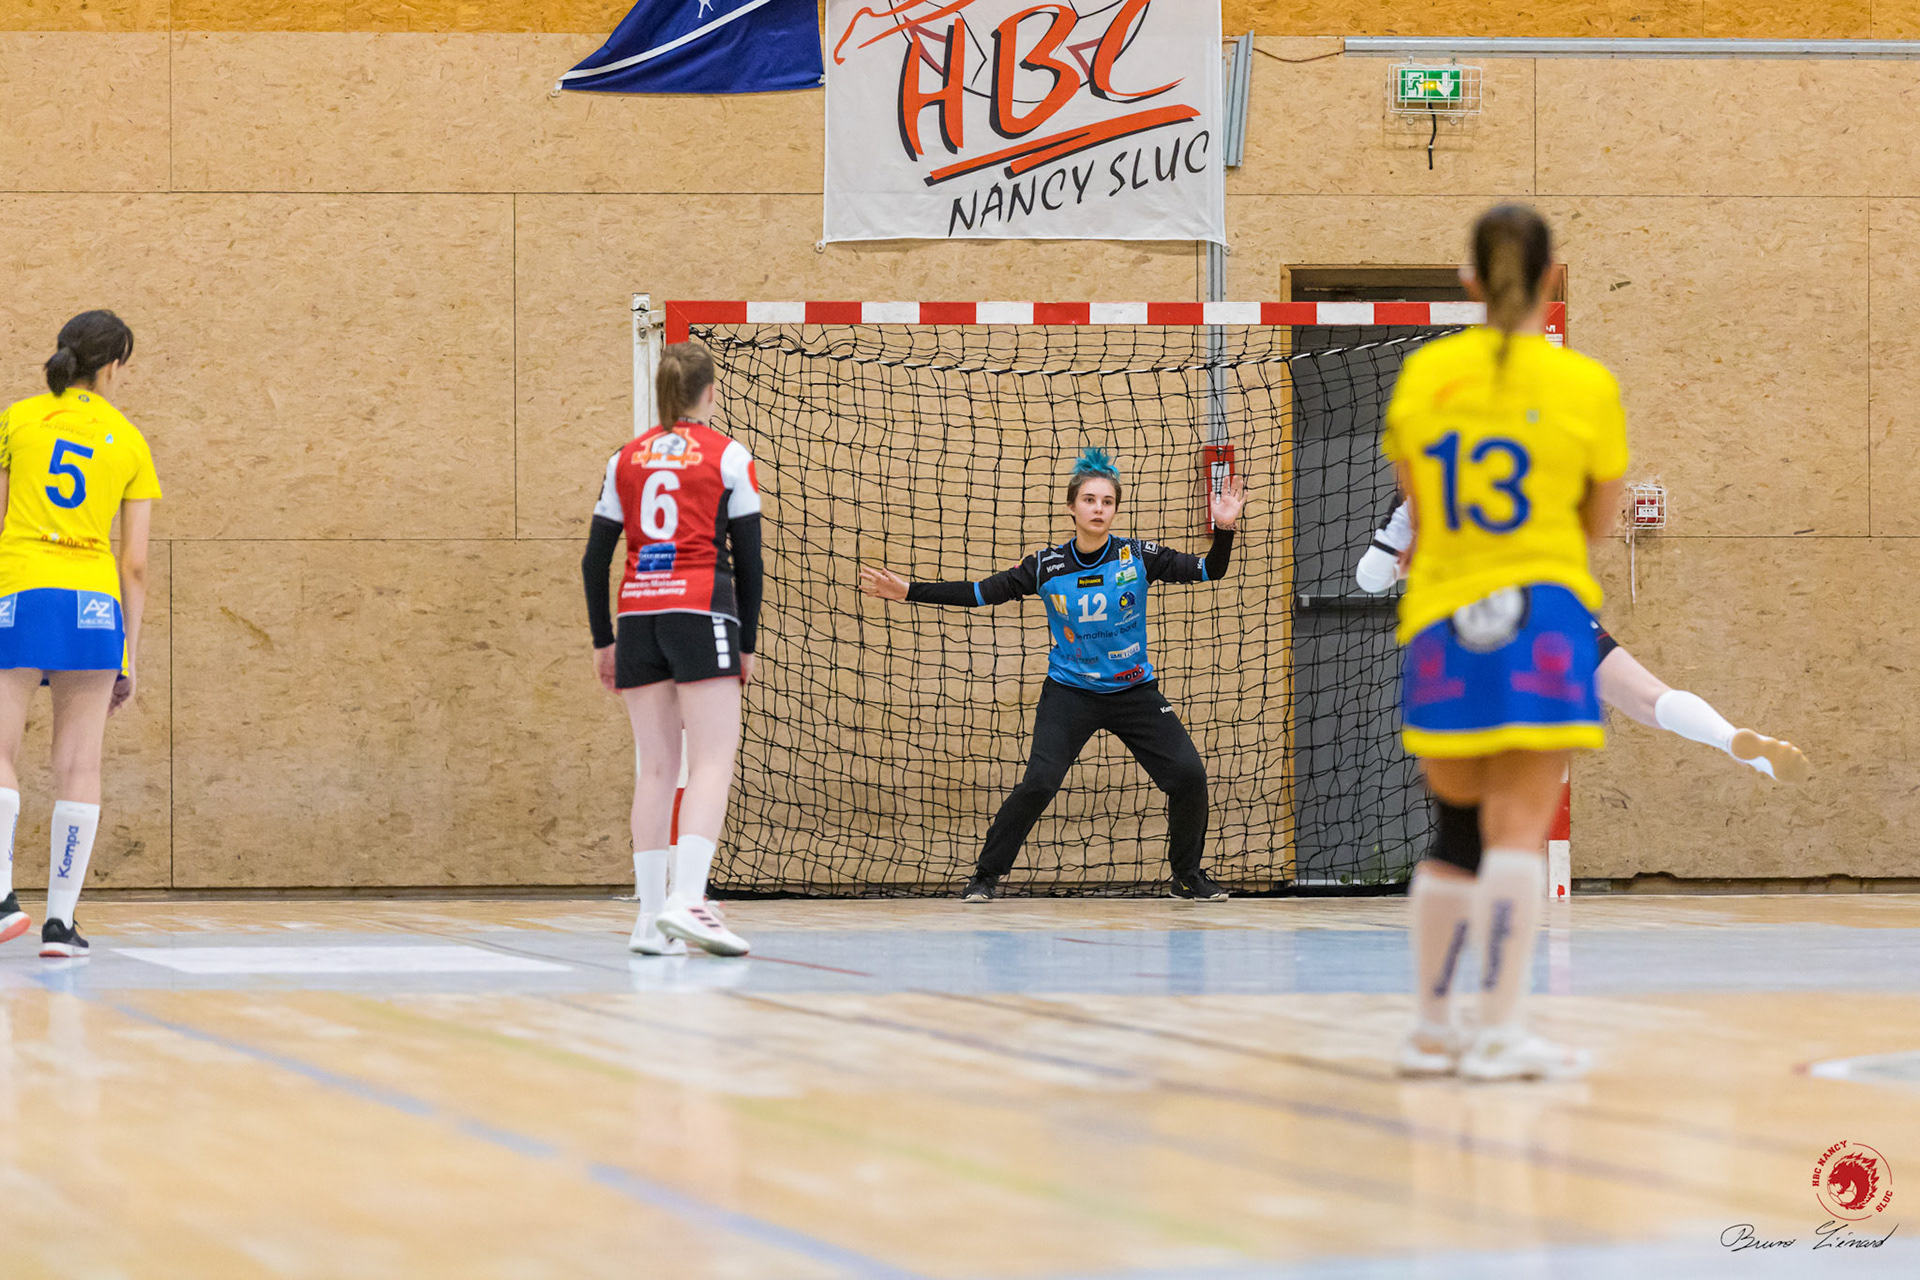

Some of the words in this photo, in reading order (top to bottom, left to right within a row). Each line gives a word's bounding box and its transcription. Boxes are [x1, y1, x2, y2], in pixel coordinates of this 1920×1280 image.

[898, 0, 1186, 162] HBC
[948, 160, 1095, 237] NANCY
[1109, 130, 1210, 197] SLUC
[45, 438, 94, 509] 5
[640, 470, 681, 540] 6
[1423, 430, 1531, 534] 13
[83, 598, 111, 618] AZ
[1078, 593, 1108, 623] 12
[57, 824, 80, 879] Kempa
